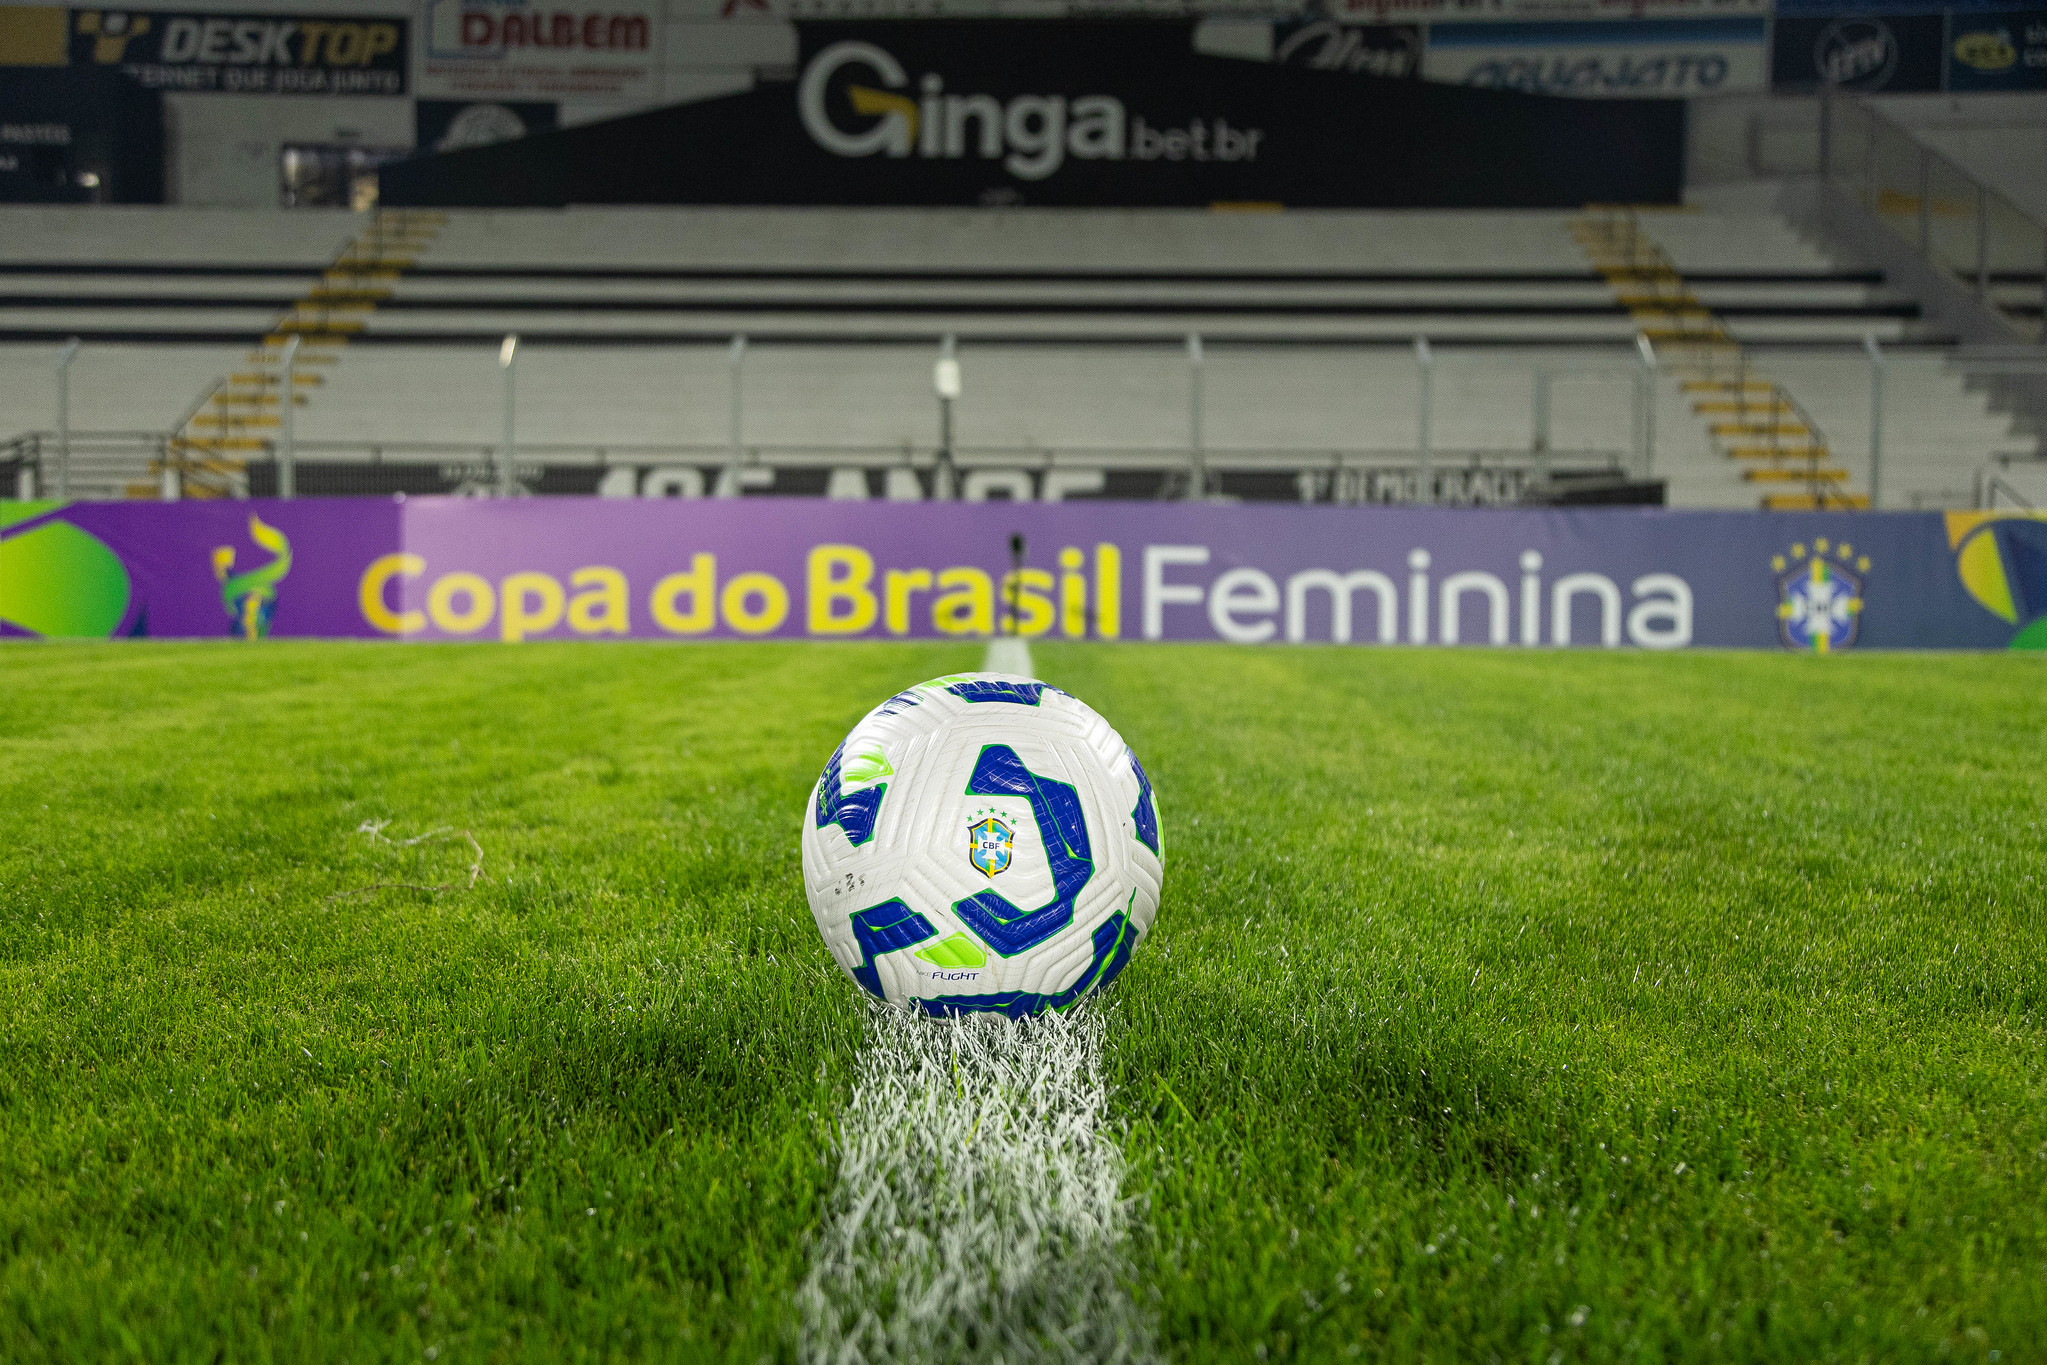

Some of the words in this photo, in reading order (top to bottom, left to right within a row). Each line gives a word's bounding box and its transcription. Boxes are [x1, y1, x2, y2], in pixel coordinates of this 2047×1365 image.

[160, 18, 400, 66] DESKTOP
[461, 12, 650, 51] DALBEM
[358, 551, 631, 643] Copa
[651, 552, 790, 635] do
[807, 542, 1122, 638] Brasil
[1142, 544, 1694, 648] Feminina
[982, 841, 1001, 850] CBF
[932, 971, 980, 981] FLIGHT
